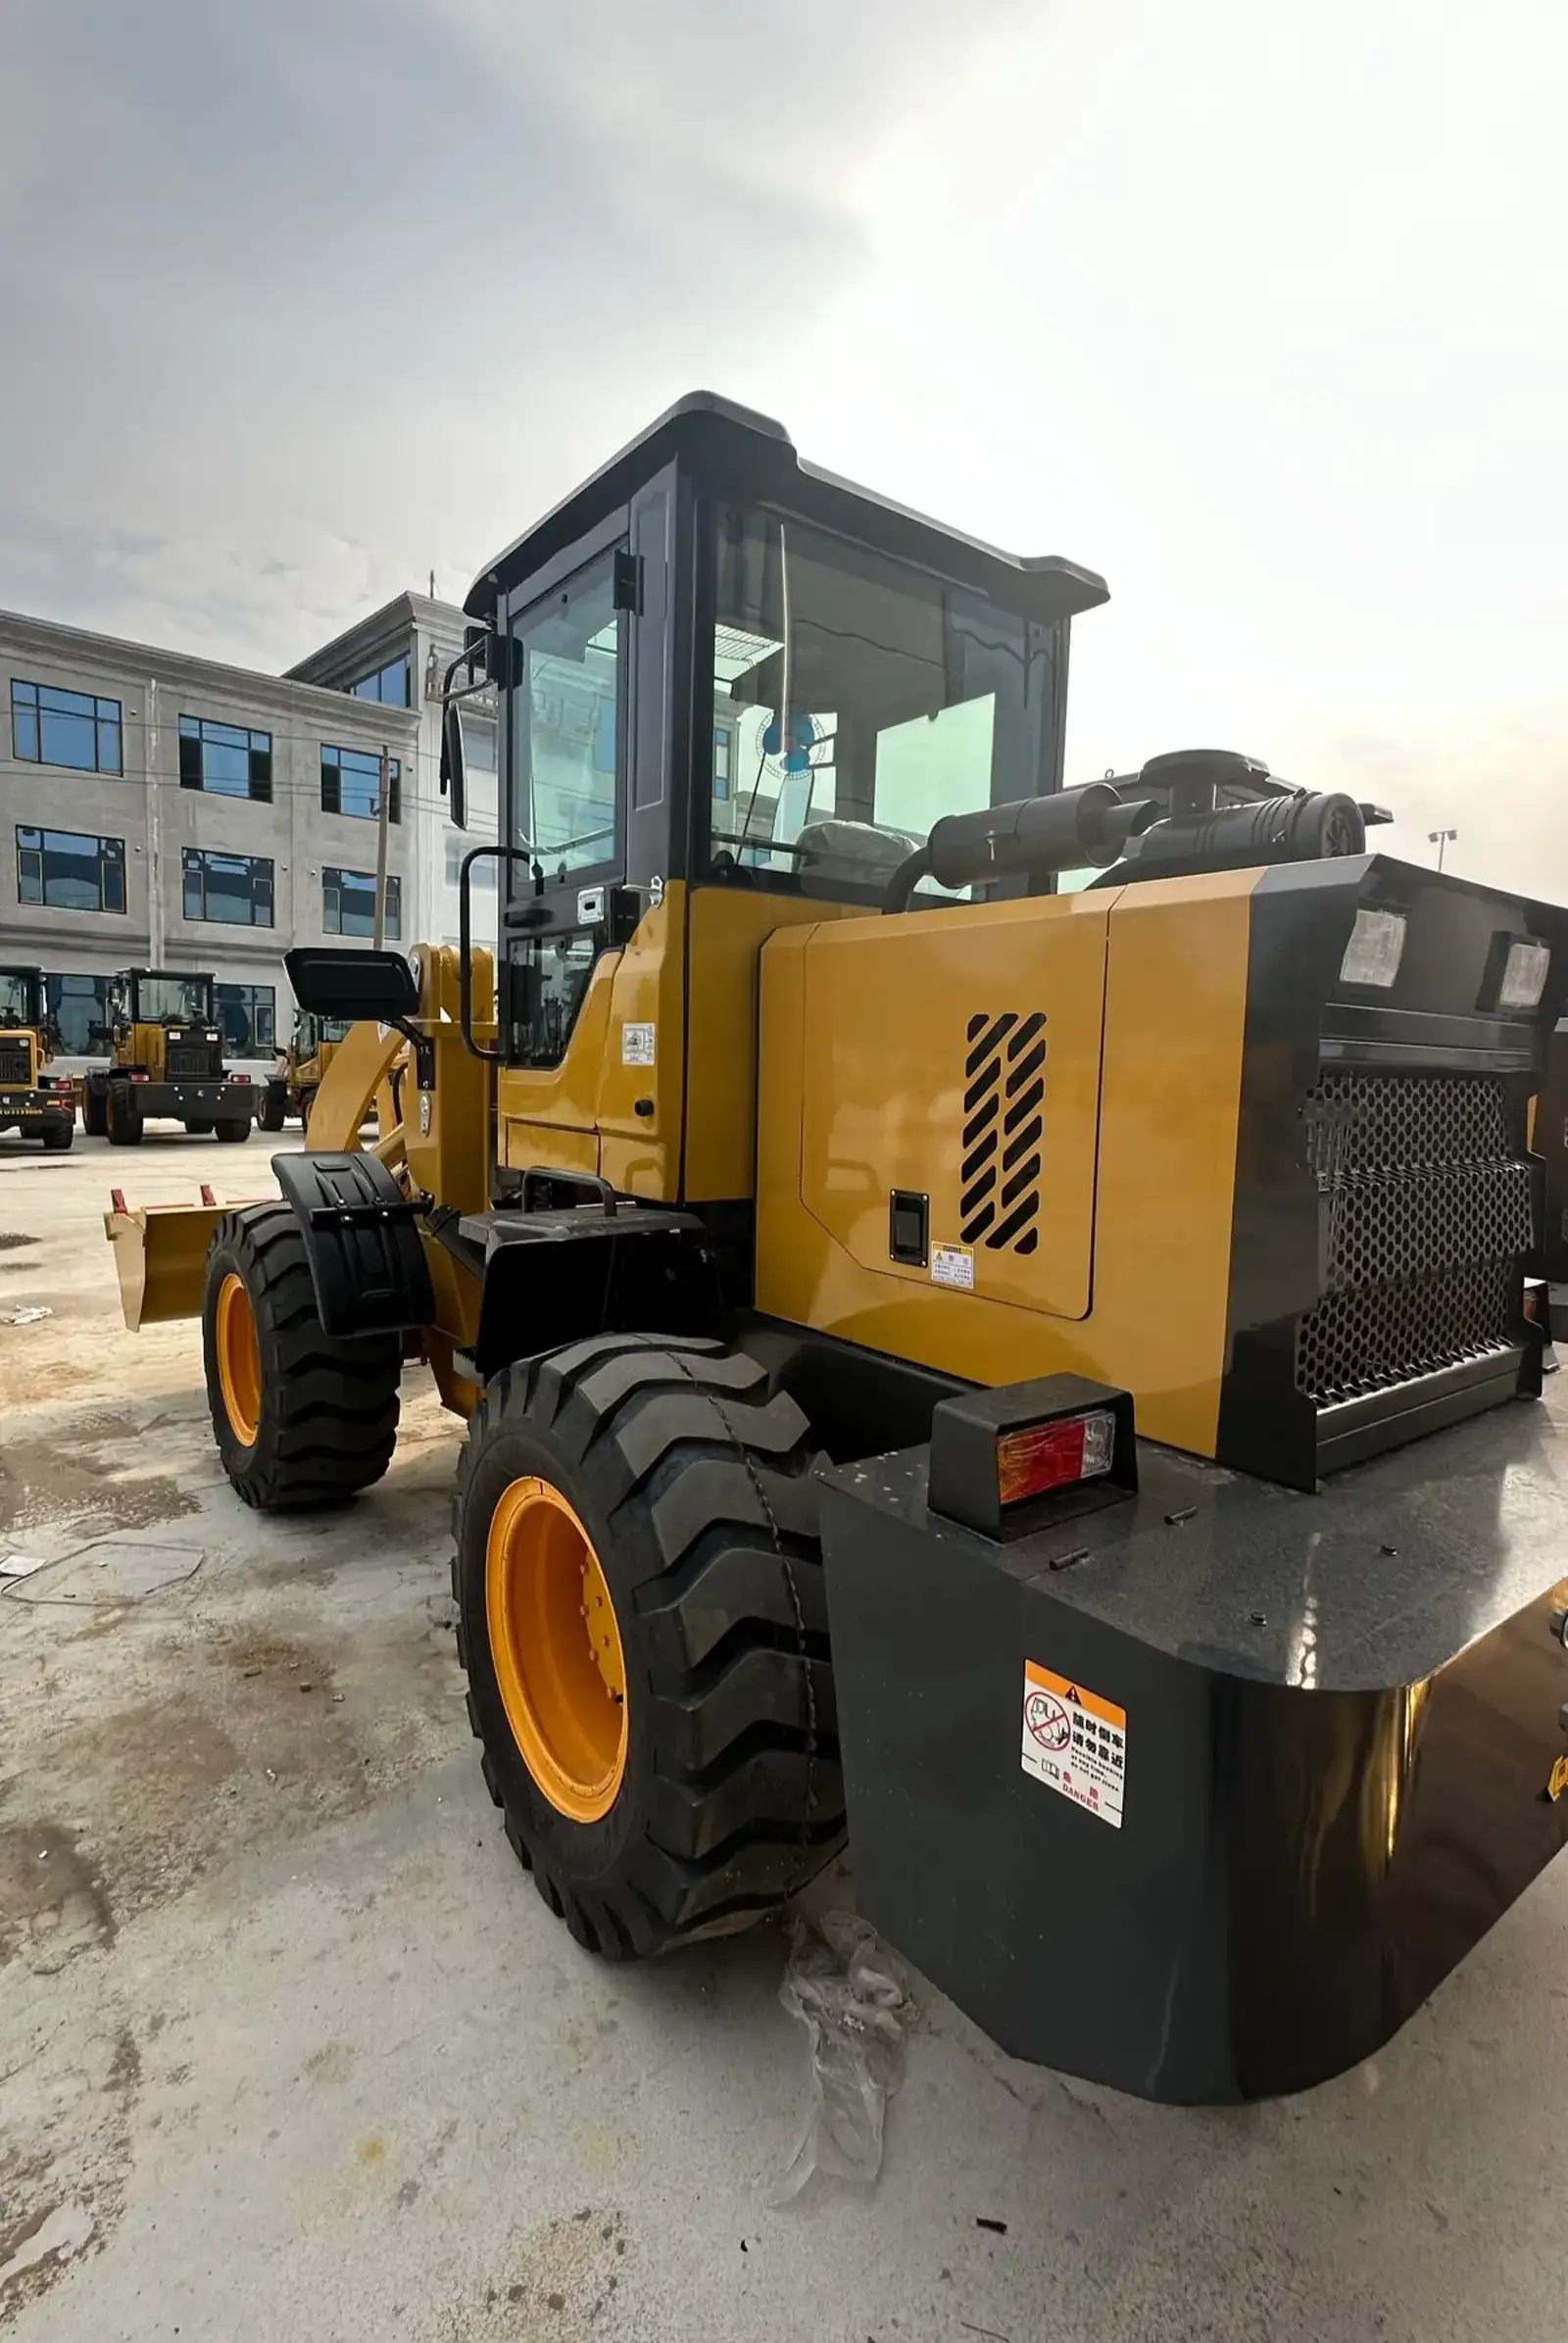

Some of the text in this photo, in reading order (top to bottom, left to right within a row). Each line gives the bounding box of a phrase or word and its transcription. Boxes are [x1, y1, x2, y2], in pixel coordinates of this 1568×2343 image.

[1073, 1711, 1124, 1748] 随时倒车
[1072, 1731, 1123, 1769] 请勿靠近
[1062, 1783, 1099, 1812] DANGER
